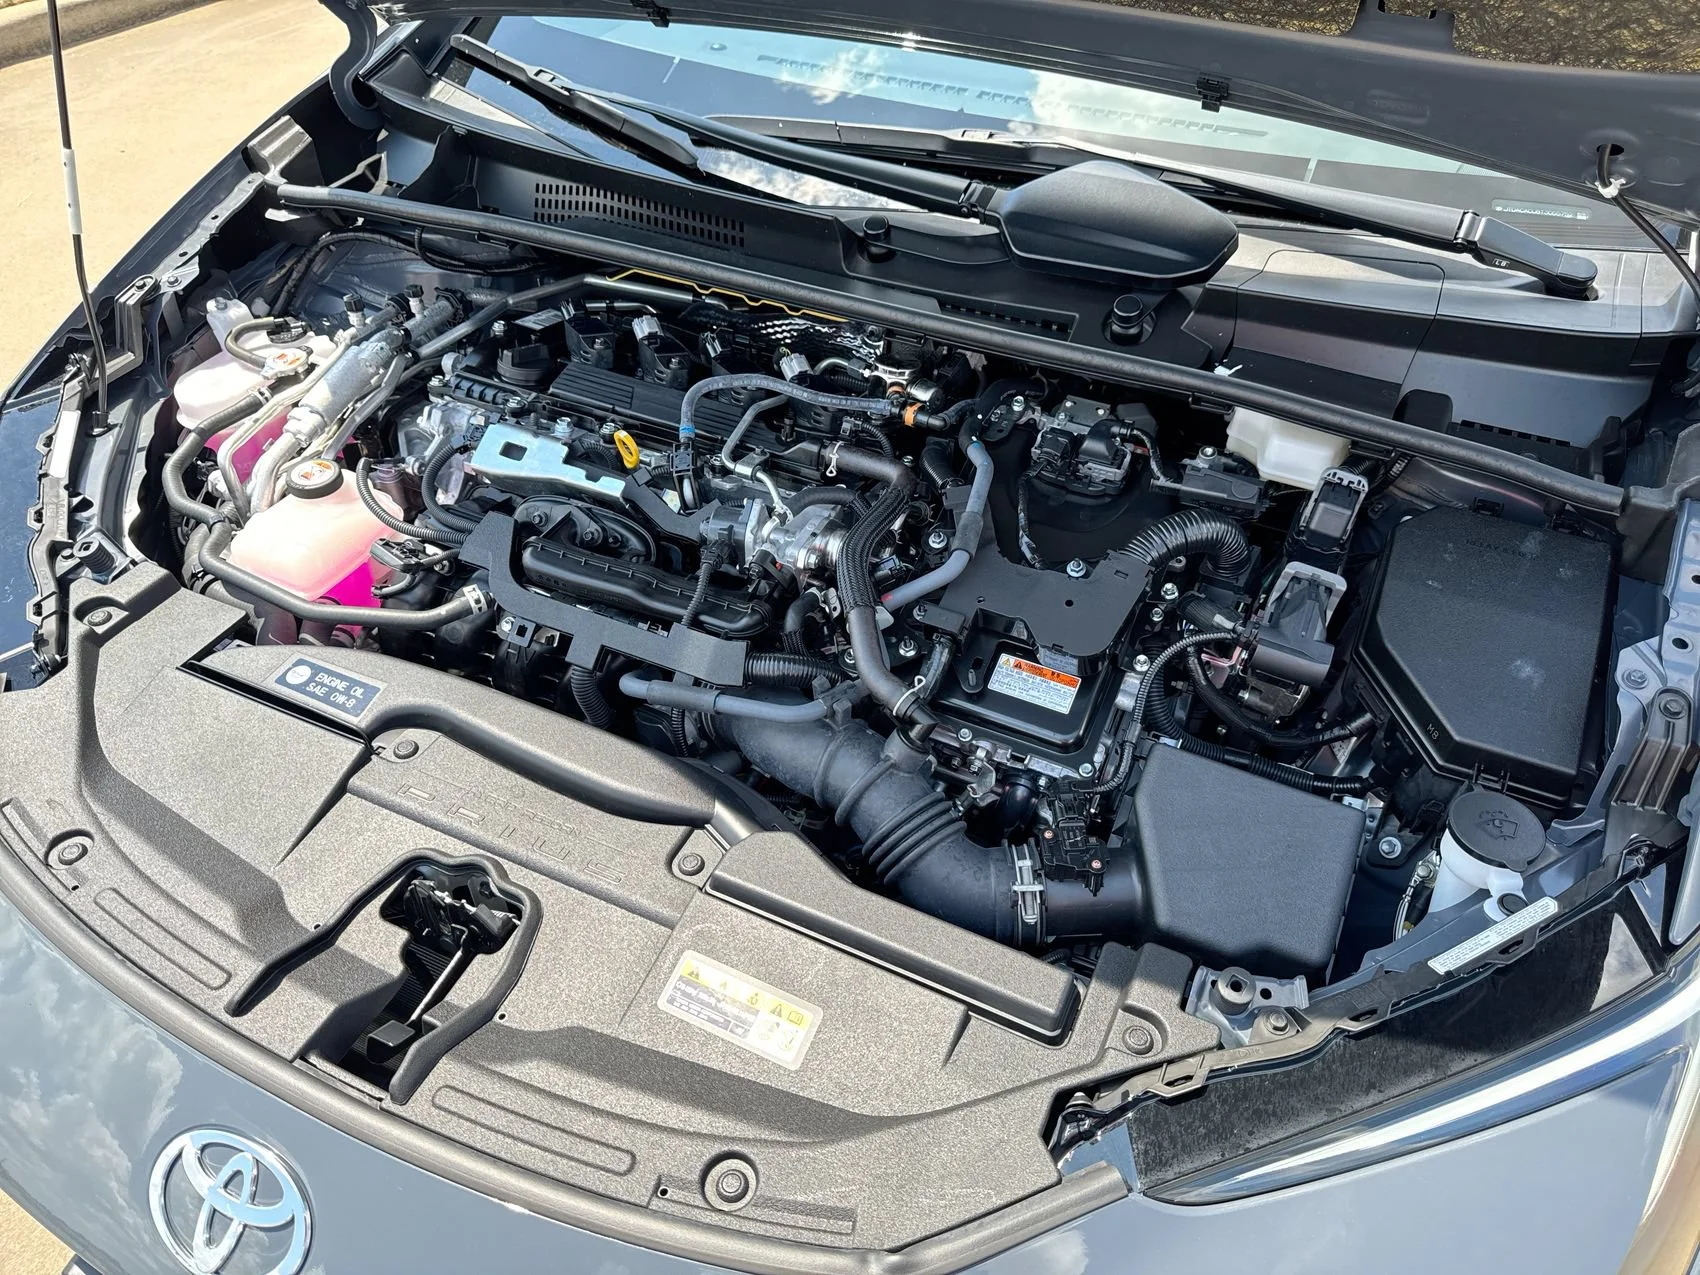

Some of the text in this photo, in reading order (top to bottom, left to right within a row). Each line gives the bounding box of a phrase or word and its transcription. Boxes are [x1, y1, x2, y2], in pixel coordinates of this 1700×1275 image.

[306, 682, 356, 708] SAE 0W-8
[315, 673, 364, 698] ENGINE OIL
[398, 782, 625, 884] PRIUS
